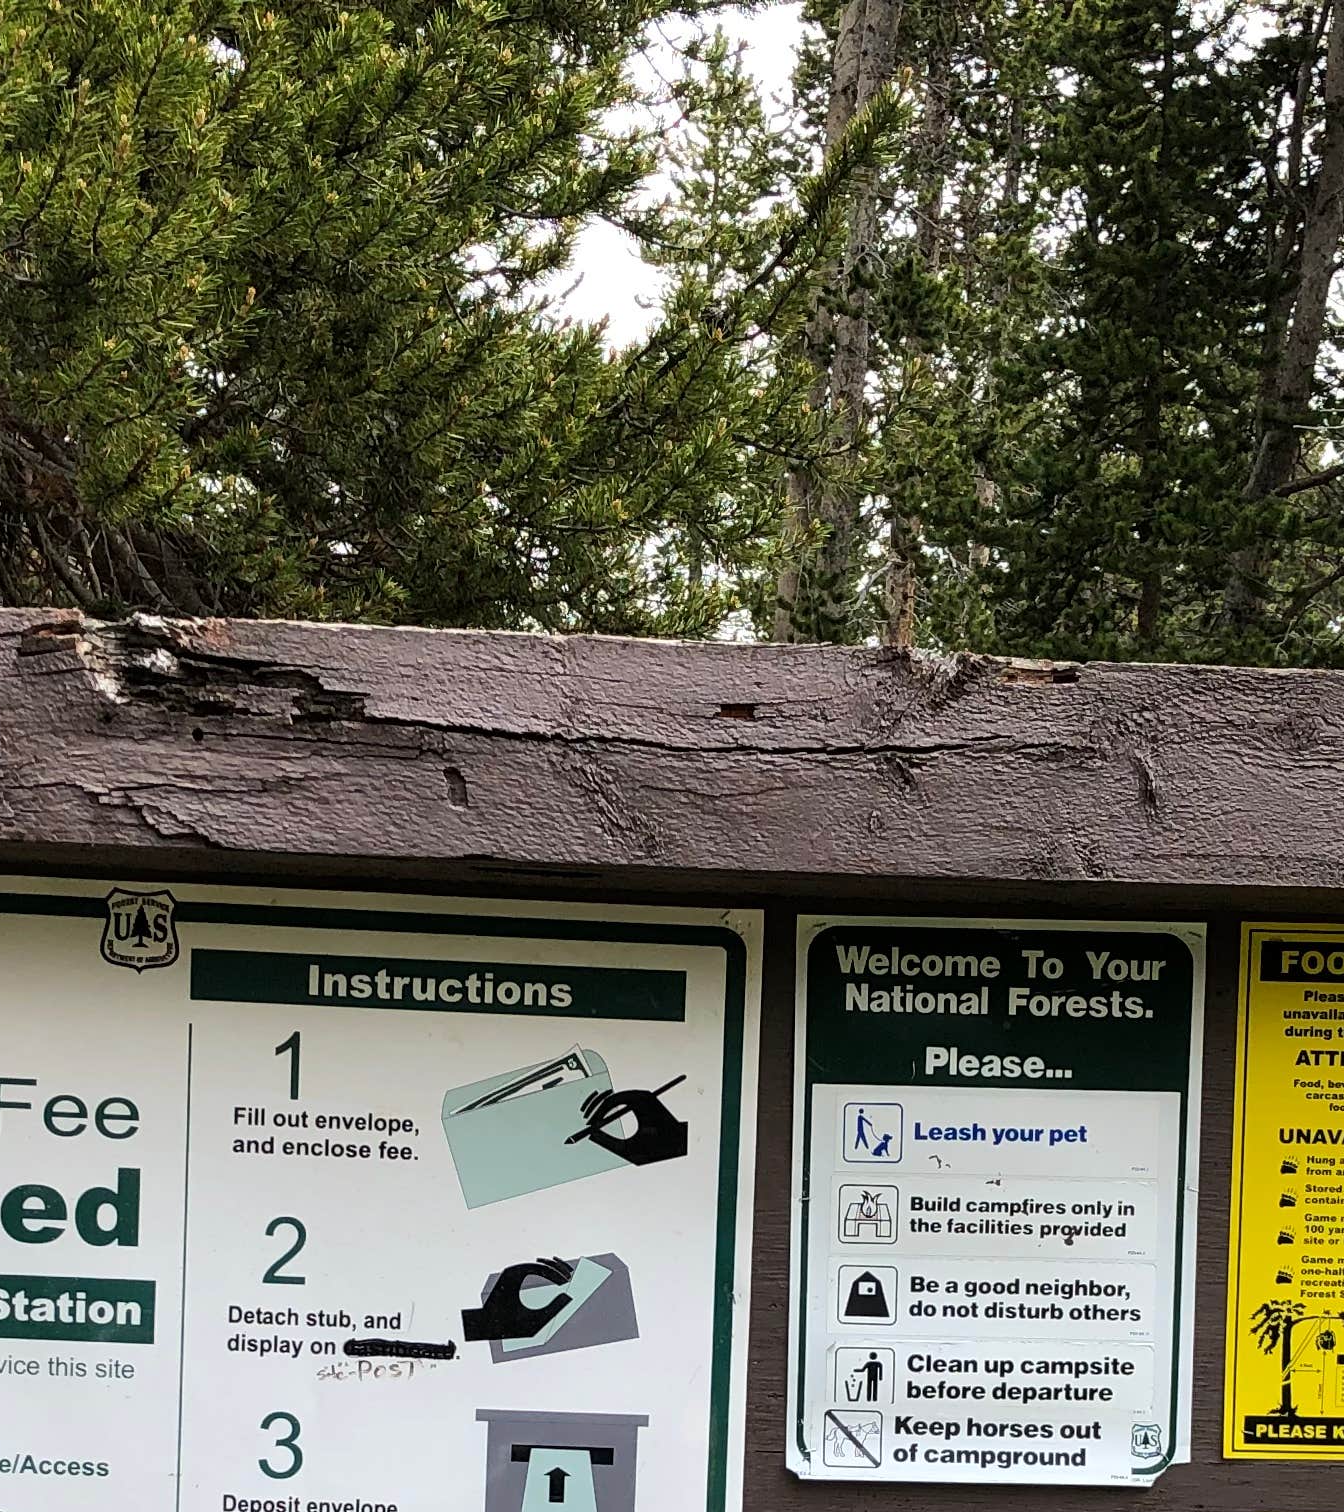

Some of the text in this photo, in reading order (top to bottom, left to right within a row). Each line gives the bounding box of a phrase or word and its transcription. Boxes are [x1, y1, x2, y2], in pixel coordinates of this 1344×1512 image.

[836, 946, 1166, 981] Welcome To Your
[309, 965, 573, 1007] Instructions
[845, 984, 1154, 1018] National Forests.
[275, 1031, 301, 1099] 1
[925, 1047, 1072, 1079] Please...
[233, 1107, 420, 1136] Fill out envelope,
[915, 1122, 1088, 1145] Leash your pet
[232, 1137, 418, 1160] and enclose fee.
[262, 1217, 307, 1285] 2
[228, 1306, 401, 1332] Detach stub, and
[227, 1335, 303, 1358] display
[310, 1338, 336, 1355] on
[48, 1357, 87, 1378] this
[96, 1359, 135, 1379] site
[907, 1354, 1135, 1378] Clean up campsite
[907, 1381, 1114, 1404] before departure
[894, 1416, 1101, 1441] Keep horses out
[1256, 1424, 1324, 1440] PLEASE
[258, 1412, 303, 1479] 3
[894, 1443, 1086, 1469] of campground
